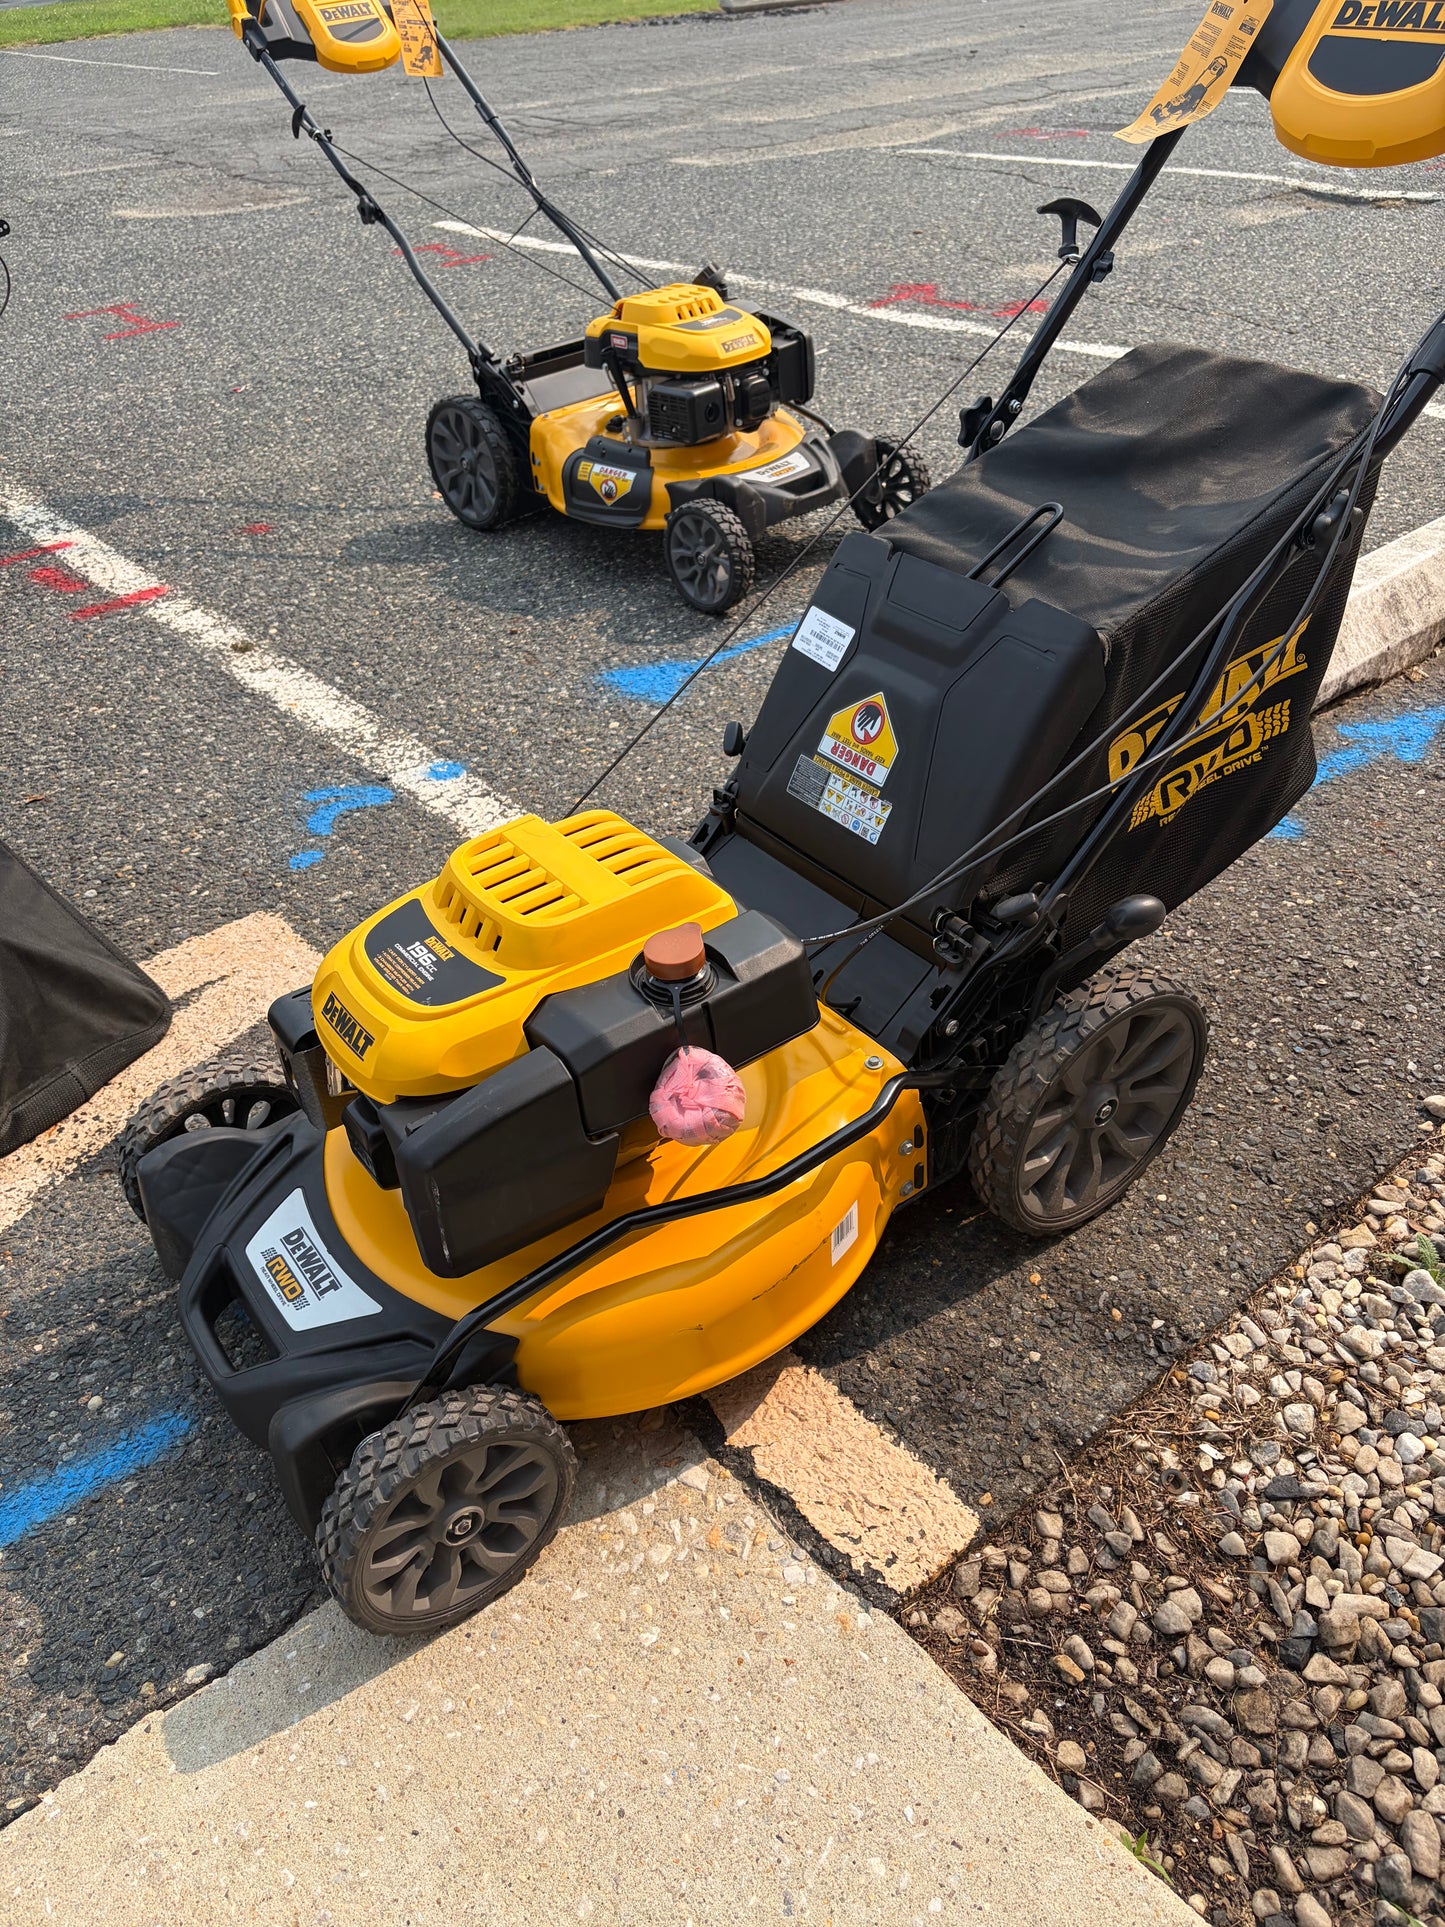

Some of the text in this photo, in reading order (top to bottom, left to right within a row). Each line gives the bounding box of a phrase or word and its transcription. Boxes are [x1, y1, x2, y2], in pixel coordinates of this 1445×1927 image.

[321, 4, 372, 21] DEWALT
[1333, 1, 1445, 29] DEWAL
[829, 741, 877, 776] DANGER
[394, 943, 434, 982] COMMERCIAL ENGINE
[425, 936, 453, 961] DEWALT
[322, 993, 374, 1057] DEWALT
[266, 1255, 304, 1301] RWD
[282, 1227, 340, 1300] DEWALT
